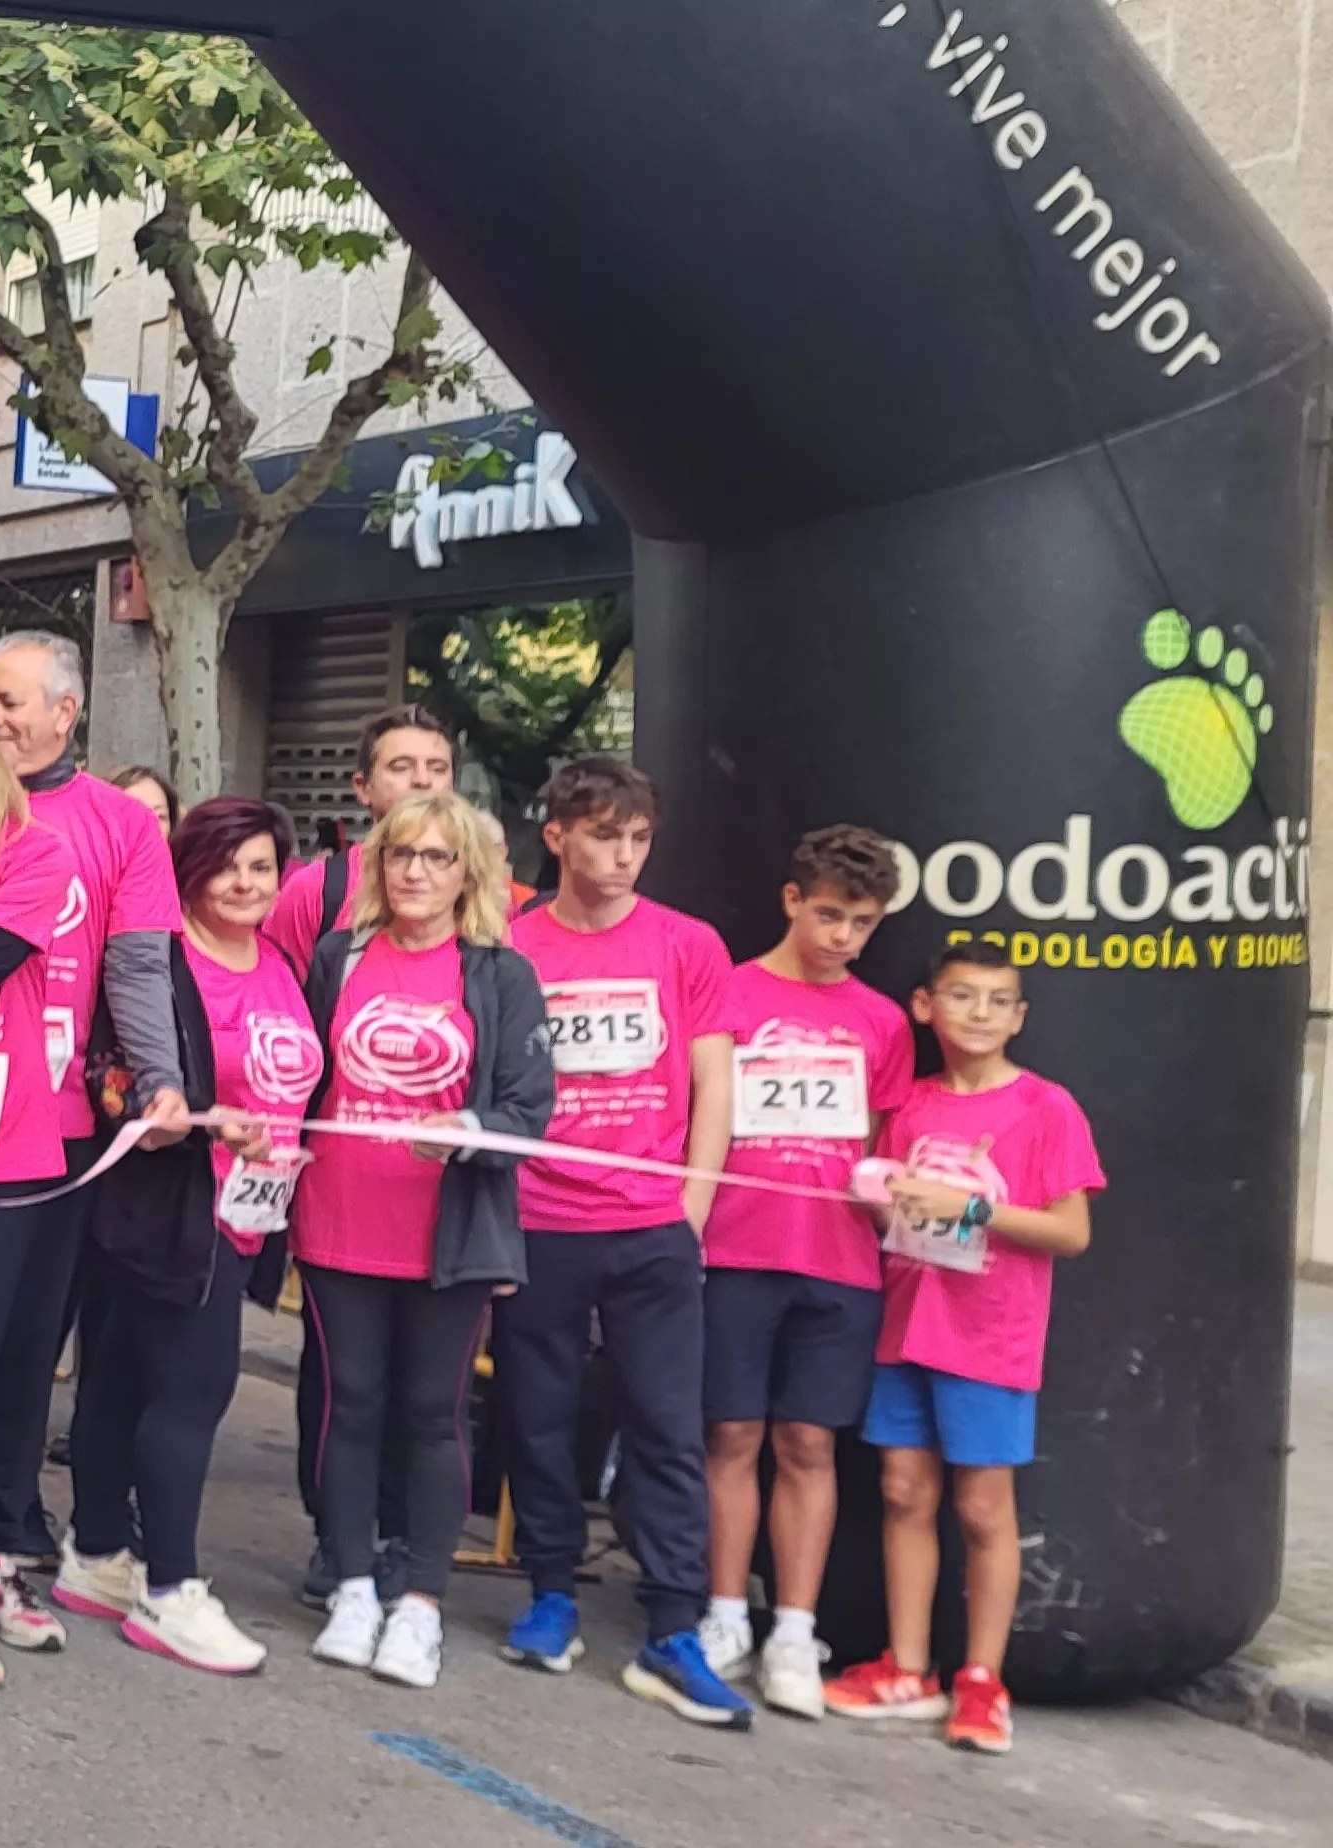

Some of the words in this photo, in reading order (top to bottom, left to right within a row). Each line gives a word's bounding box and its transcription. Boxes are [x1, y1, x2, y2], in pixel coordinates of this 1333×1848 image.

[925, 9, 1048, 170] vive
[1034, 165, 1222, 378] mejor
[947, 926, 1197, 969] DOLOGÍA
[1208, 935, 1226, 969] Y
[547, 1013, 645, 1045] 2815
[760, 1078, 839, 1108] 212
[234, 1178, 292, 1209] 280
